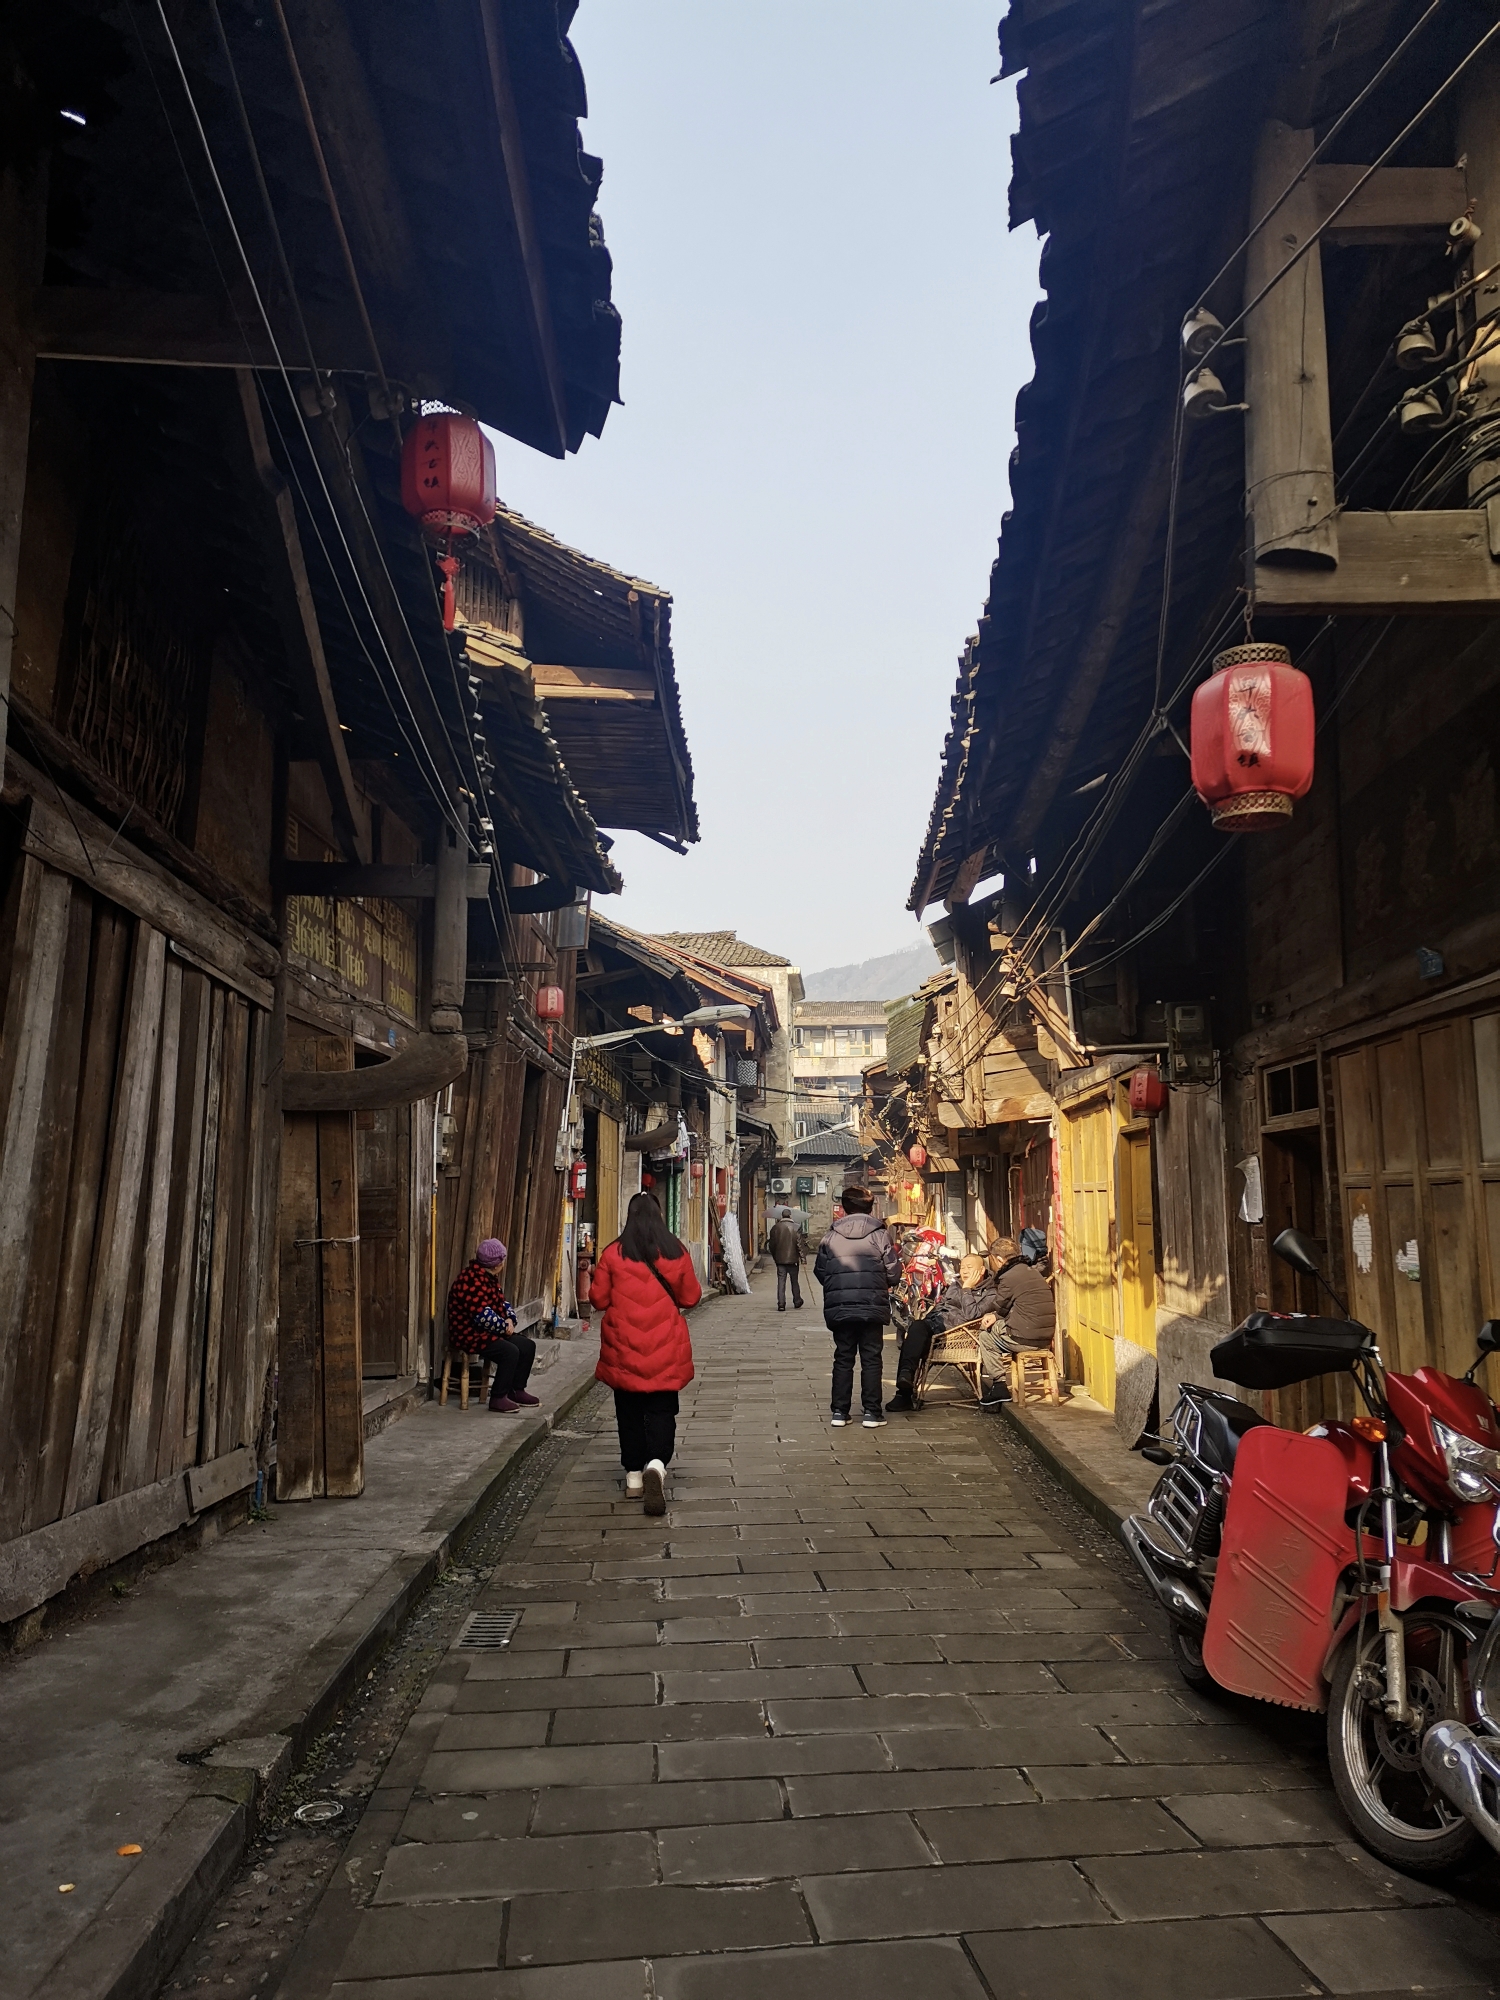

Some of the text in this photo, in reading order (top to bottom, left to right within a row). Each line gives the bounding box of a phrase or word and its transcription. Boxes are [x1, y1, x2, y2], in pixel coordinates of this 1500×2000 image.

[331, 1179, 343, 1199] 7
[1260, 1533, 1301, 1648] 出入平安
